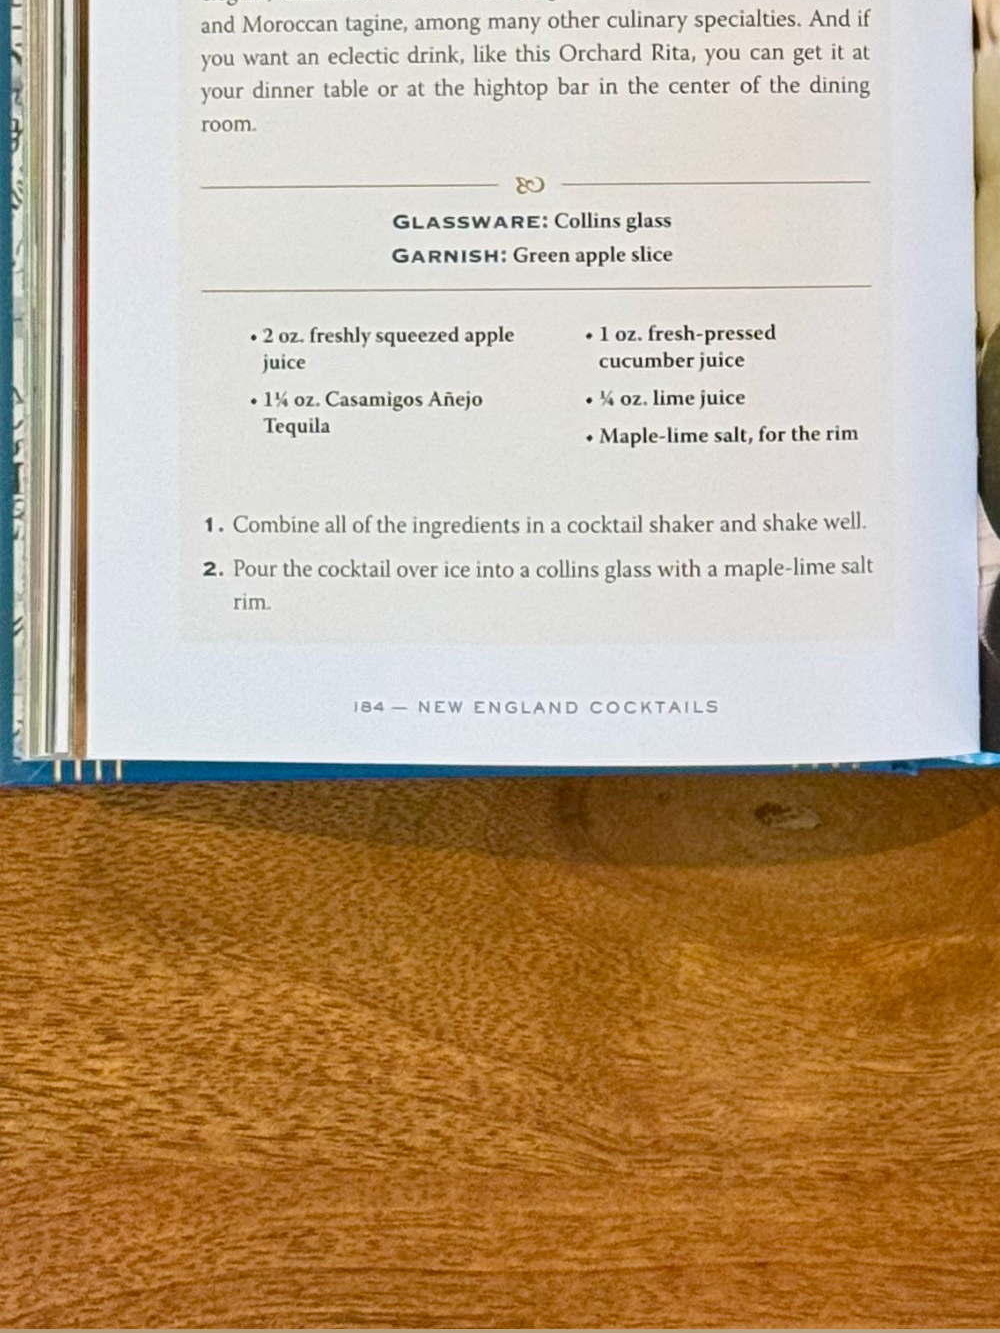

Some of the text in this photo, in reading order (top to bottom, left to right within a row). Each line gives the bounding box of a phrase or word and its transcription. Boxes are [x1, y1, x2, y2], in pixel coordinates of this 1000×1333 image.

[201, 8, 871, 37] and Moroccan tagine, among many other culinary specialties. And if
[202, 119, 256, 133] room.
[393, 211, 671, 233] GLASSWARE: Collins glass
[392, 245, 673, 267] GARNISH: Green apple slice
[263, 325, 514, 348] 2 oz. freshly squeezed apple
[601, 323, 776, 345] 1 oz. fresh-pressed
[263, 354, 305, 374] juice
[599, 351, 744, 372] cucumber juice
[294, 396, 320, 407] oz.
[325, 391, 423, 412] Casamigos
[428, 390, 483, 411] Añejo
[620, 394, 647, 406] oz.
[653, 389, 695, 406] lime
[700, 389, 745, 410] juice
[263, 417, 330, 439] Tequila
[600, 425, 858, 448] Maple-lime salt, for the rim
[205, 510, 866, 540] 1. Combine all of the ingredients in a cocktail shaker and shake well.
[203, 555, 873, 584] 2. Pour the cocktail over ice into a collins glass with a maple-lime salt
[234, 593, 271, 611] rim.
[354, 700, 718, 715] 184 NEW ENGLAND COCKTAILS
